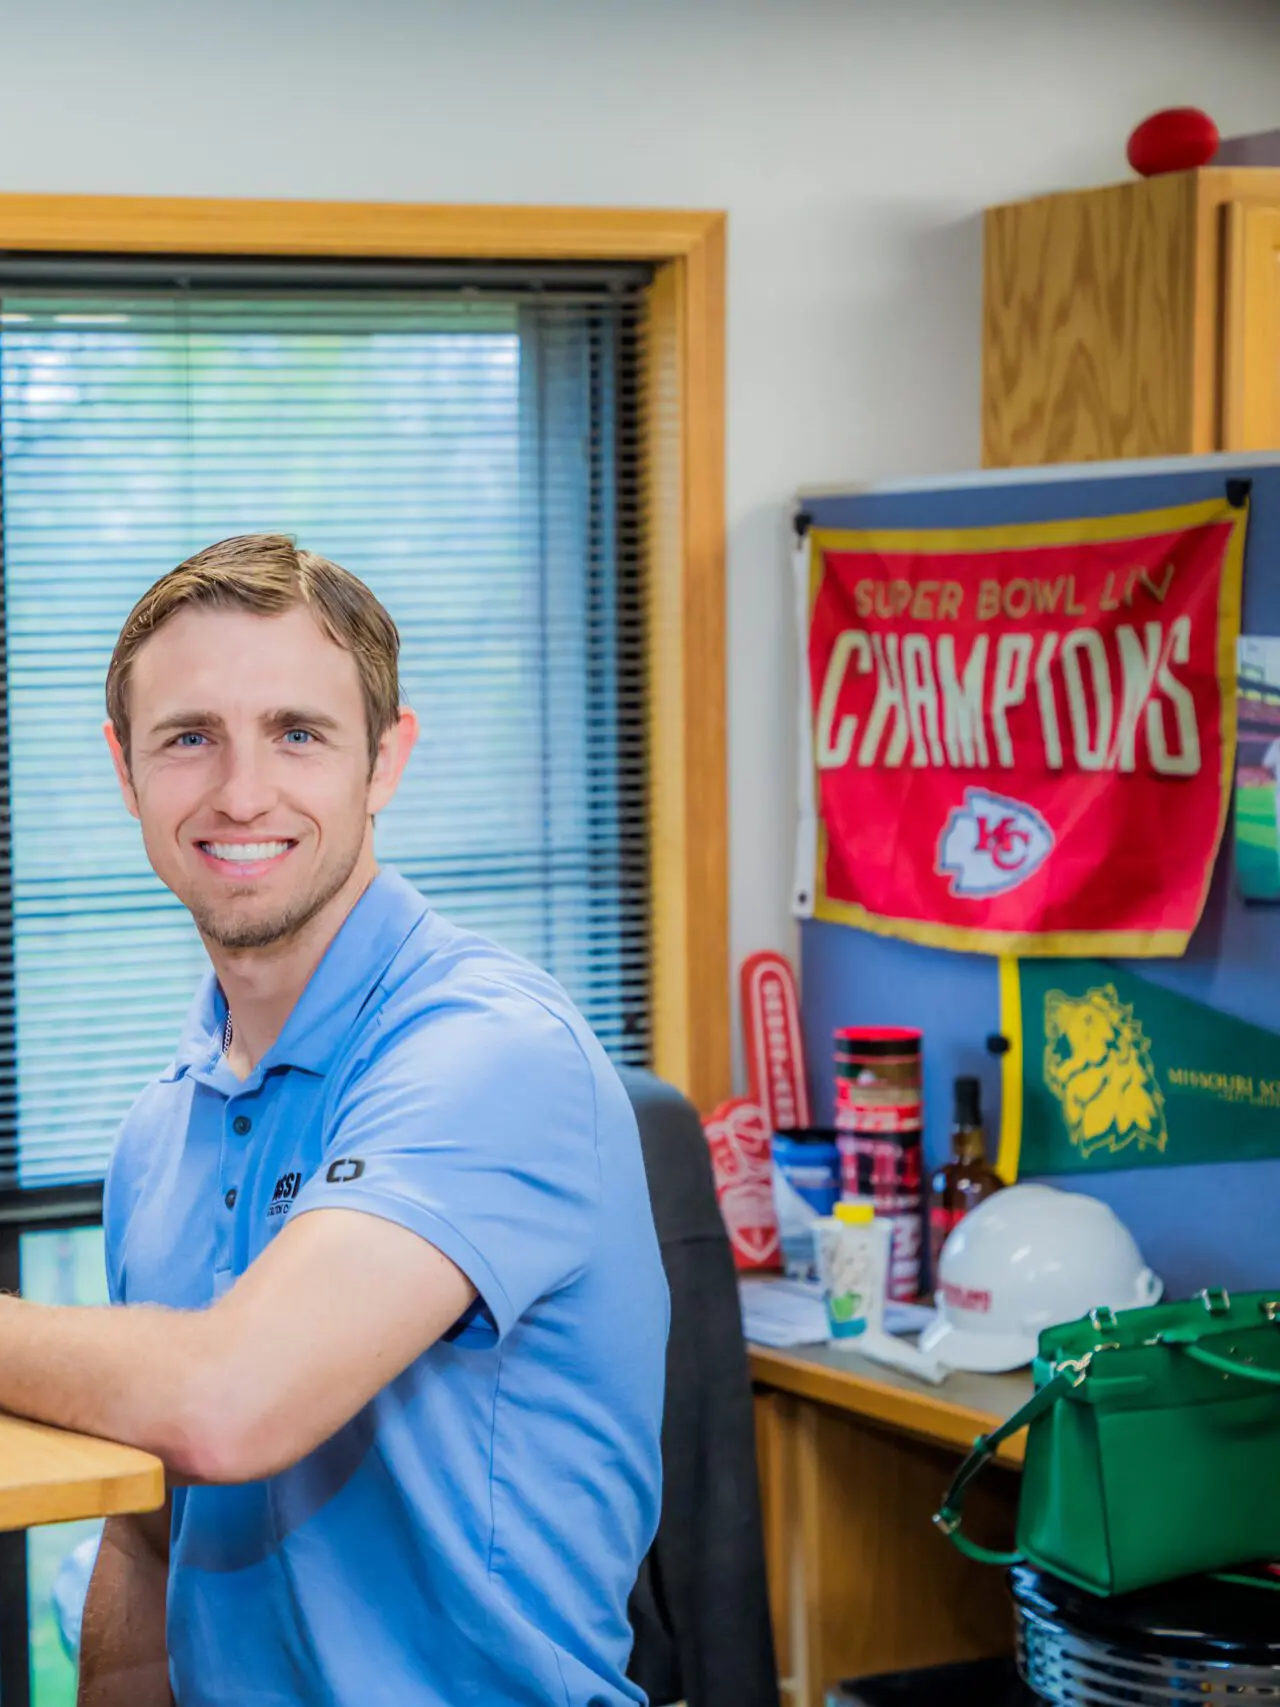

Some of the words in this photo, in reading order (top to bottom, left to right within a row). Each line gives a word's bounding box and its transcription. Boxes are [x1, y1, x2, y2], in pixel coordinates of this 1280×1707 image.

[854, 577, 964, 621] SUPER
[975, 574, 1085, 621] BOWL
[1099, 563, 1174, 612] LIV
[819, 617, 1201, 775] CHAMPIONS
